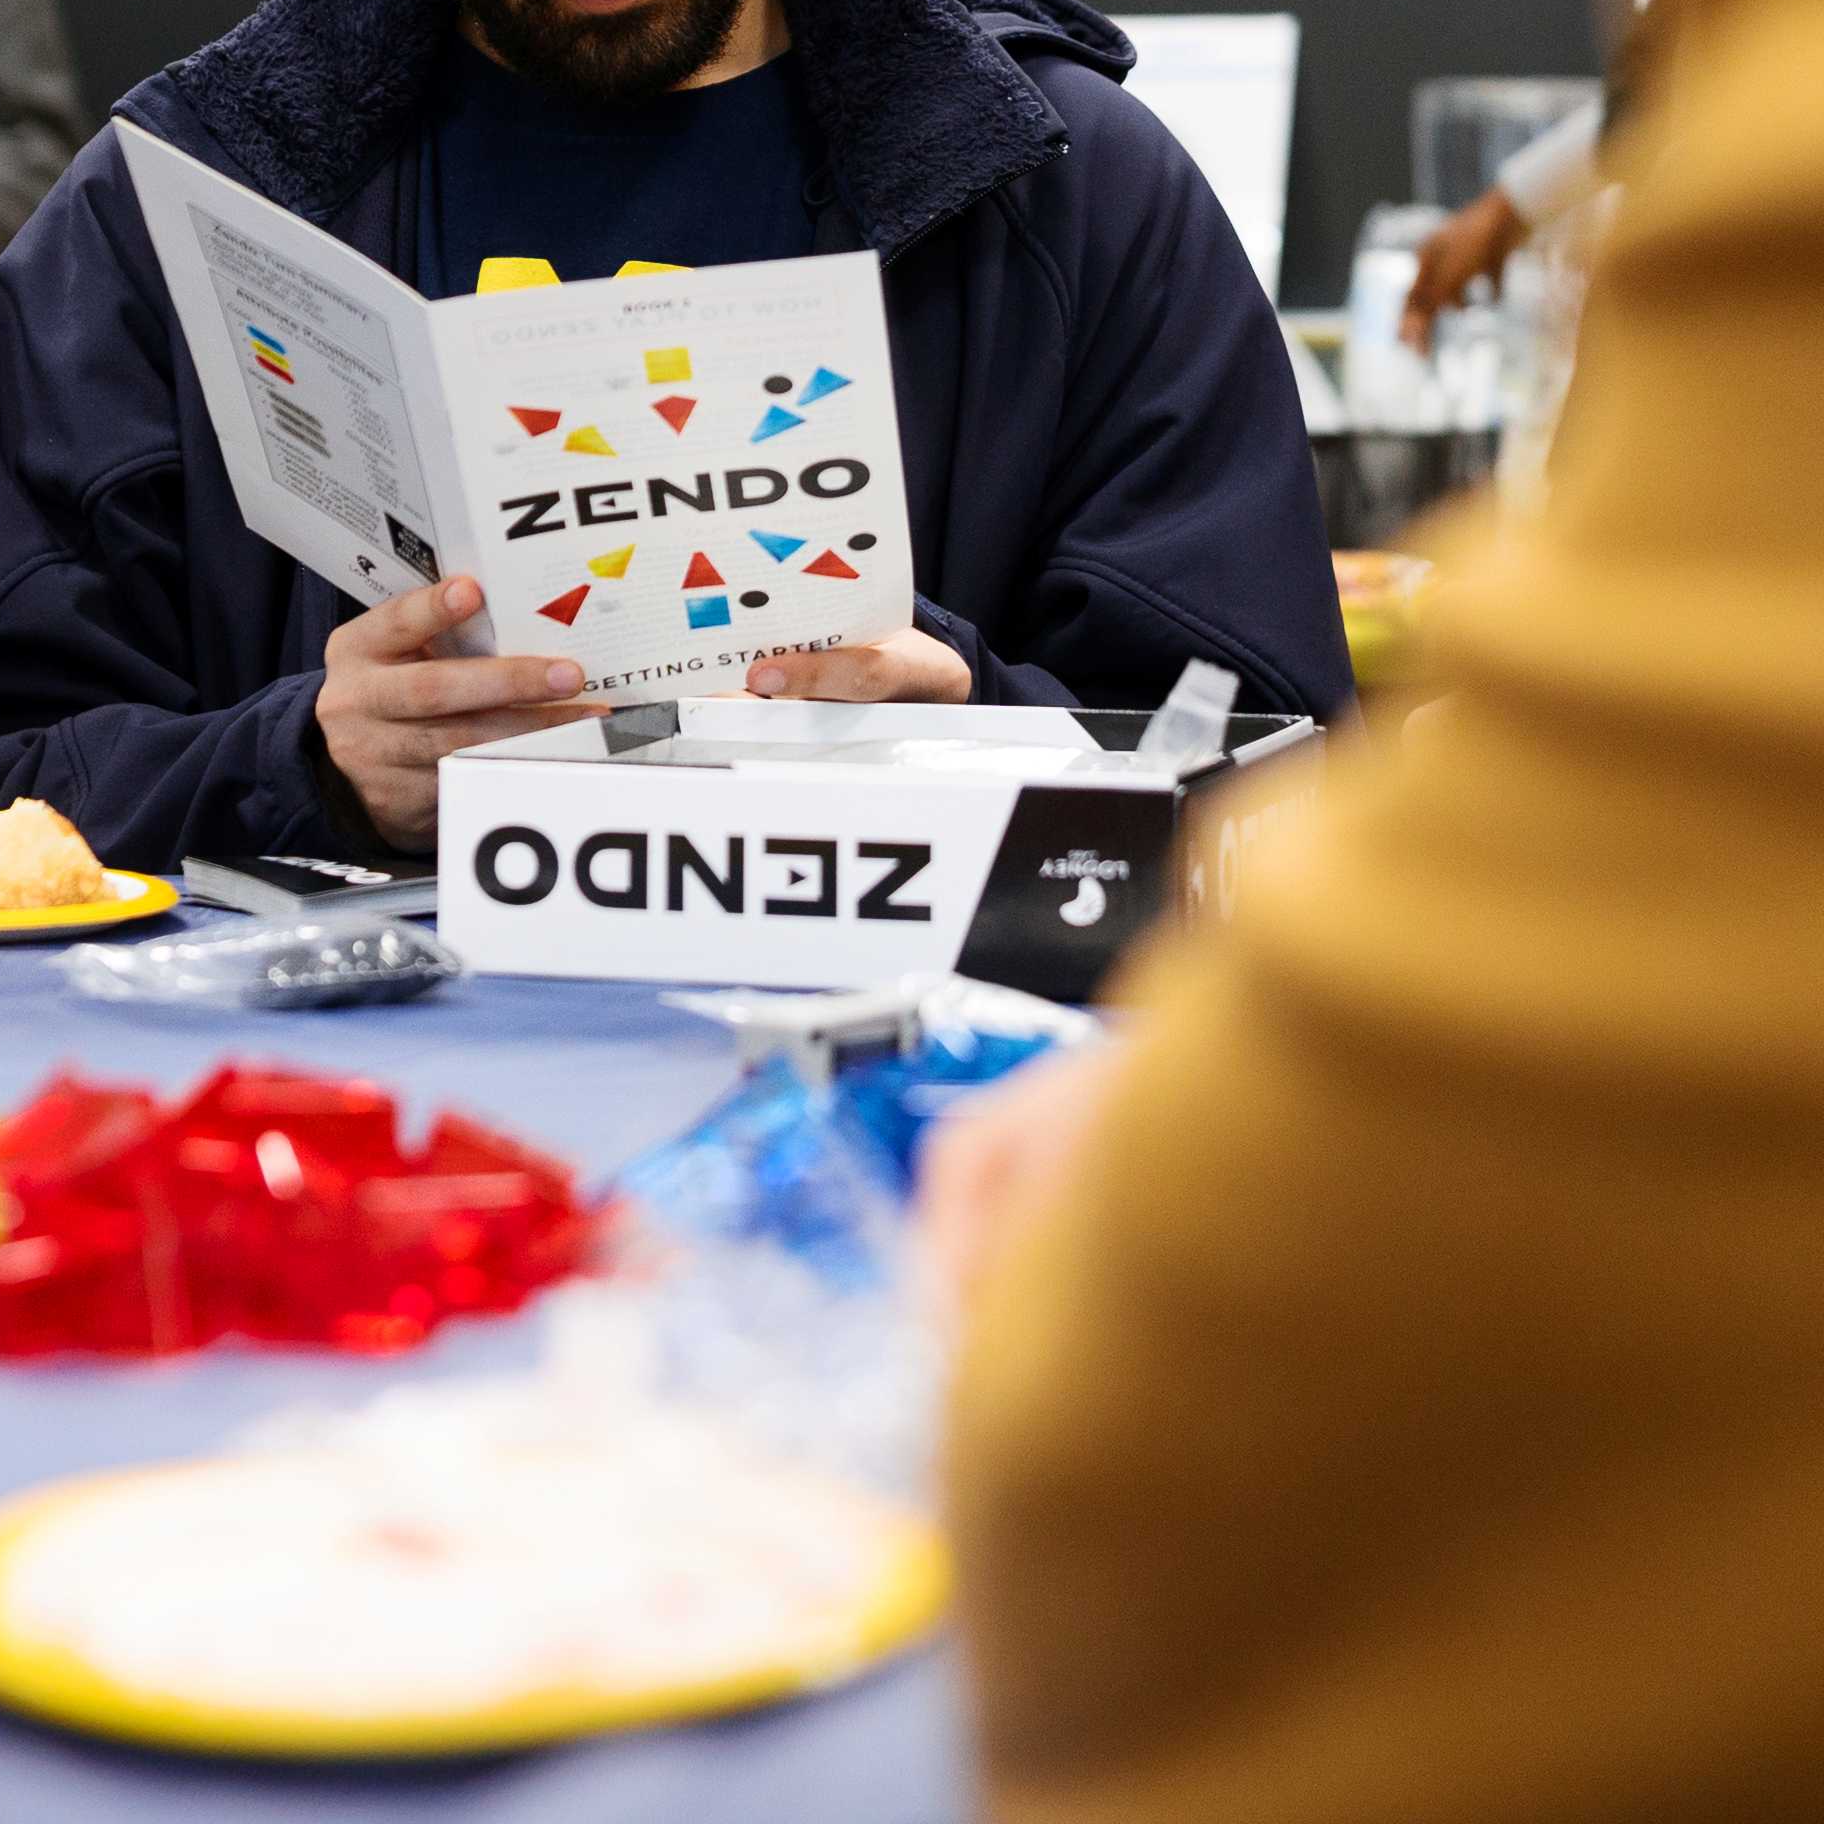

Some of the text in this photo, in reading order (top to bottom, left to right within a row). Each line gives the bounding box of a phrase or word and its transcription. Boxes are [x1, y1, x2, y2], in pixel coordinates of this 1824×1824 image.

[500, 457, 871, 542] ZENDO
[582, 656, 705, 694] GETTING
[472, 824, 933, 924] ZENDO
